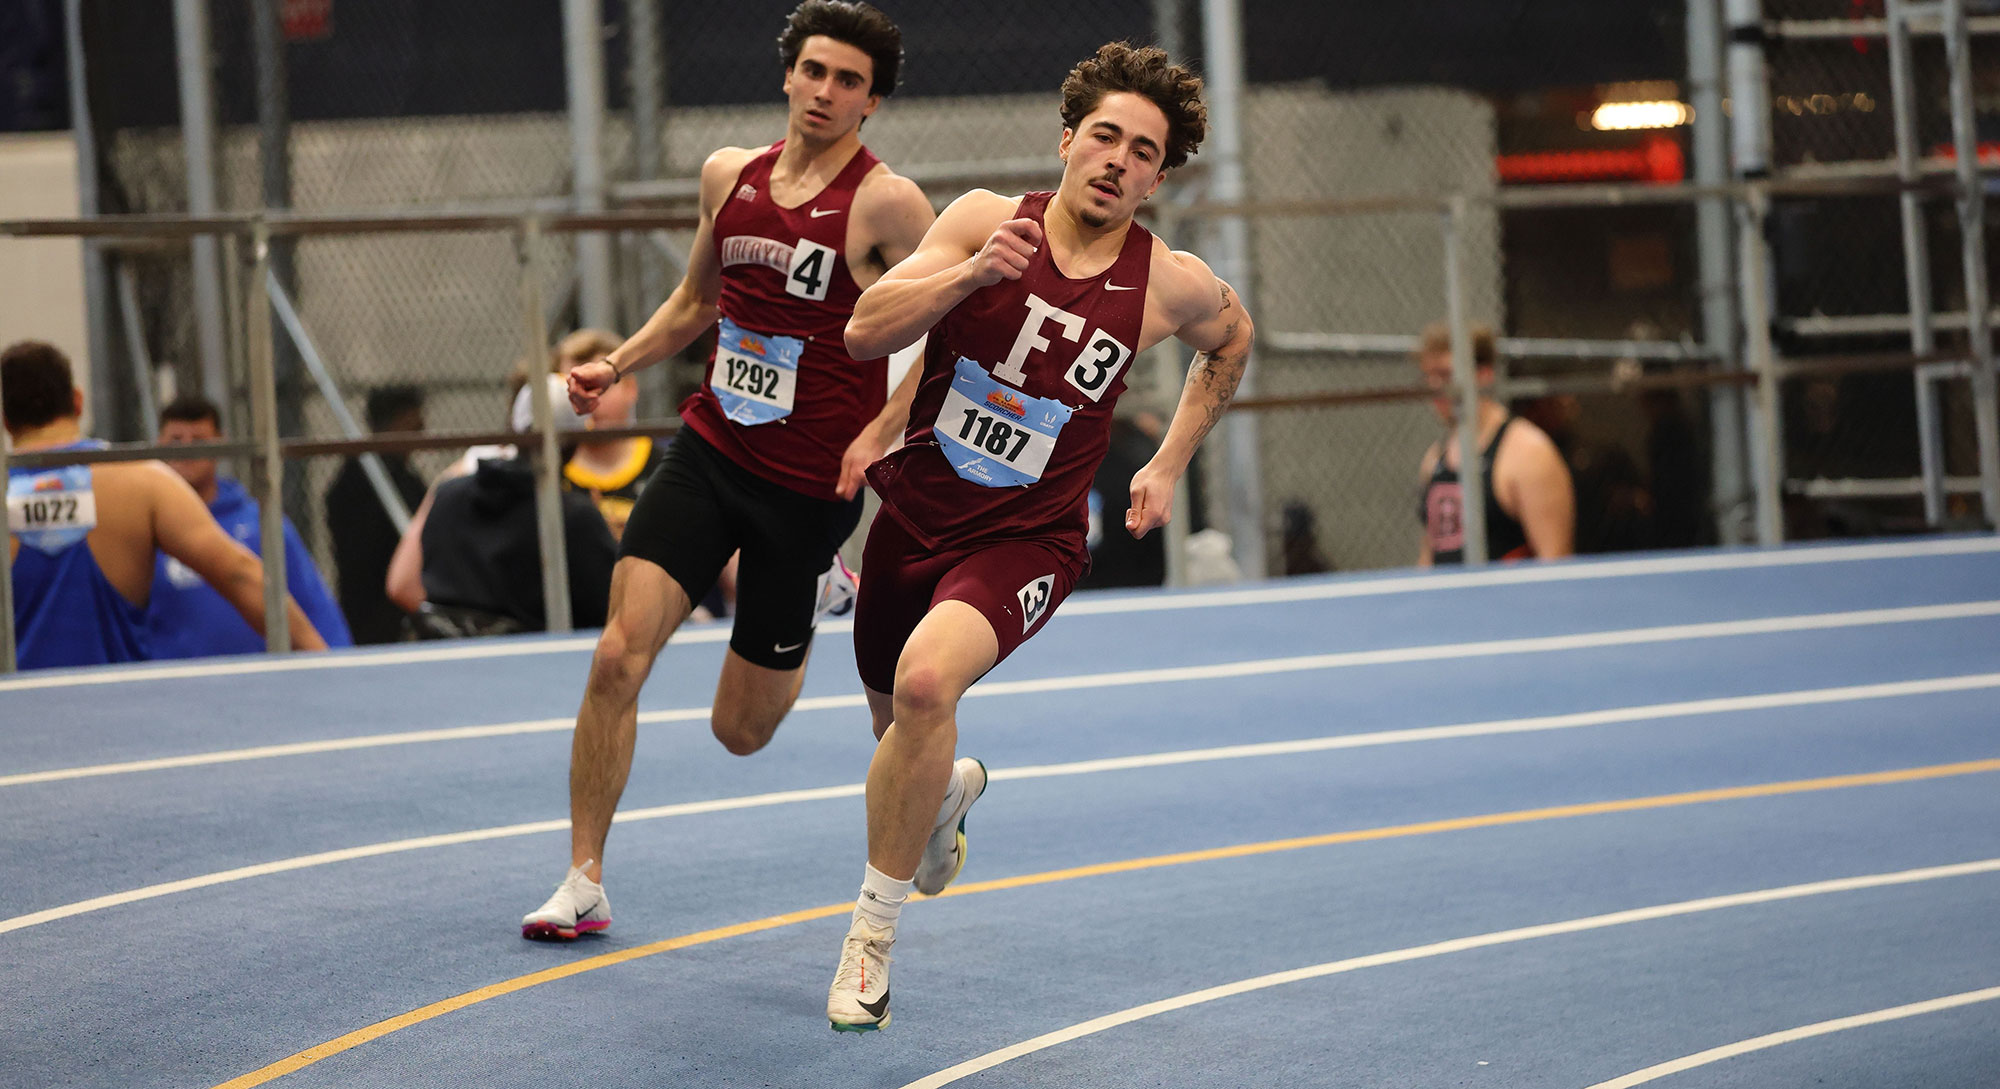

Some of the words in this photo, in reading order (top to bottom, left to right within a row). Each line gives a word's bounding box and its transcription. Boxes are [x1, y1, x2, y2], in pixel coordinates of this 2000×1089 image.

[722, 236, 795, 273] LAFAYET
[793, 249, 825, 295] 4
[992, 293, 1087, 388] F
[726, 357, 779, 400] 1292
[1074, 339, 1121, 391] 3
[958, 408, 1032, 463] 1187
[1023, 581, 1049, 623] 3
